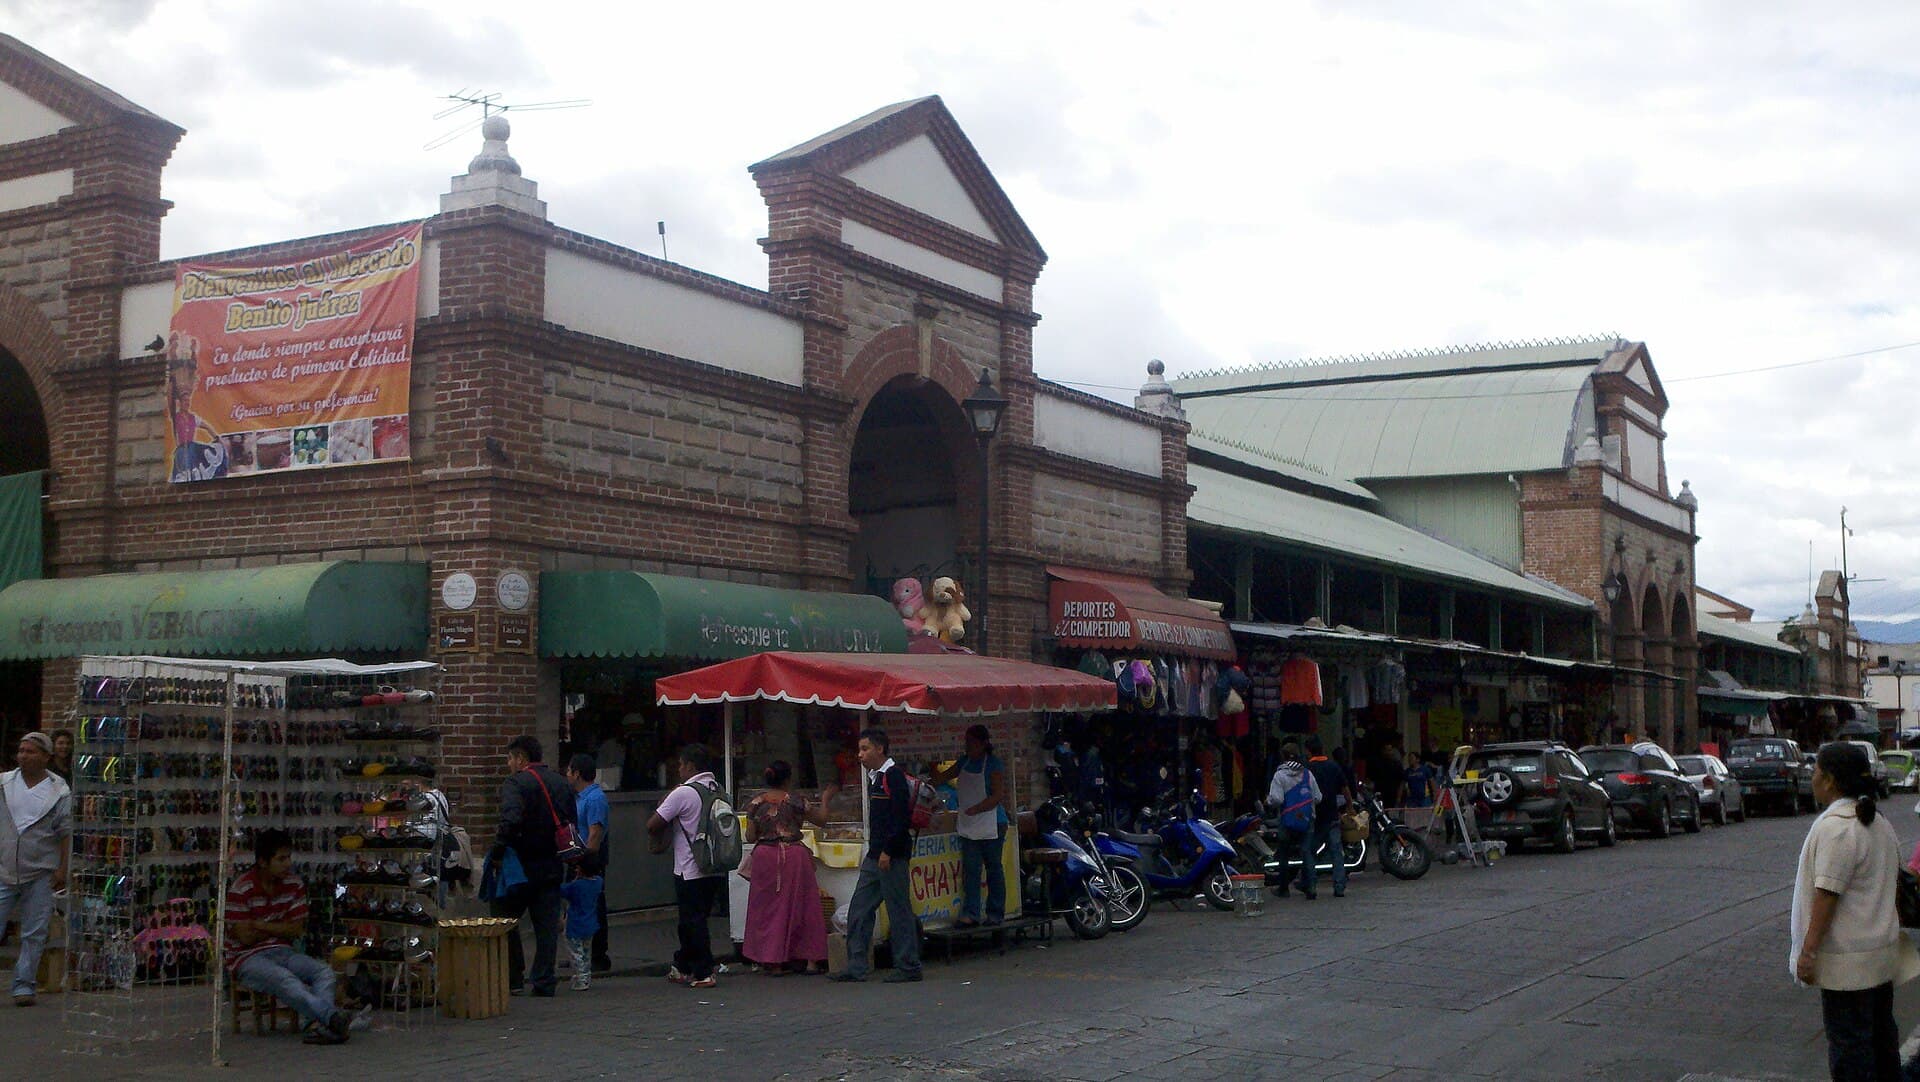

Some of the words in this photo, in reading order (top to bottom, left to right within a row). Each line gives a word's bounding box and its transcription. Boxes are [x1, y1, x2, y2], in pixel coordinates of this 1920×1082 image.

[183, 266, 297, 300] Bienvenidos
[302, 259, 325, 284] al
[328, 239, 414, 280] Mercado
[226, 300, 292, 331] Benito
[295, 290, 360, 329] Juárez
[214, 347, 229, 365] En
[233, 342, 271, 362] donde
[274, 339, 326, 358] siempre
[329, 324, 403, 349] encontrará
[206, 367, 268, 392] productos
[272, 362, 288, 378] de
[291, 359, 345, 382] primera
[346, 344, 410, 368] Calidad.
[276, 402, 294, 417] por
[297, 401, 310, 413] su
[131, 604, 257, 640] VERACRUZ
[1064, 601, 1116, 618] DEPORTES
[1054, 620, 1070, 637] El
[1071, 620, 1131, 638] COMPETIDOR
[1136, 618, 1175, 643] DEPORTES
[1185, 627, 1231, 650] COMPETIDOR
